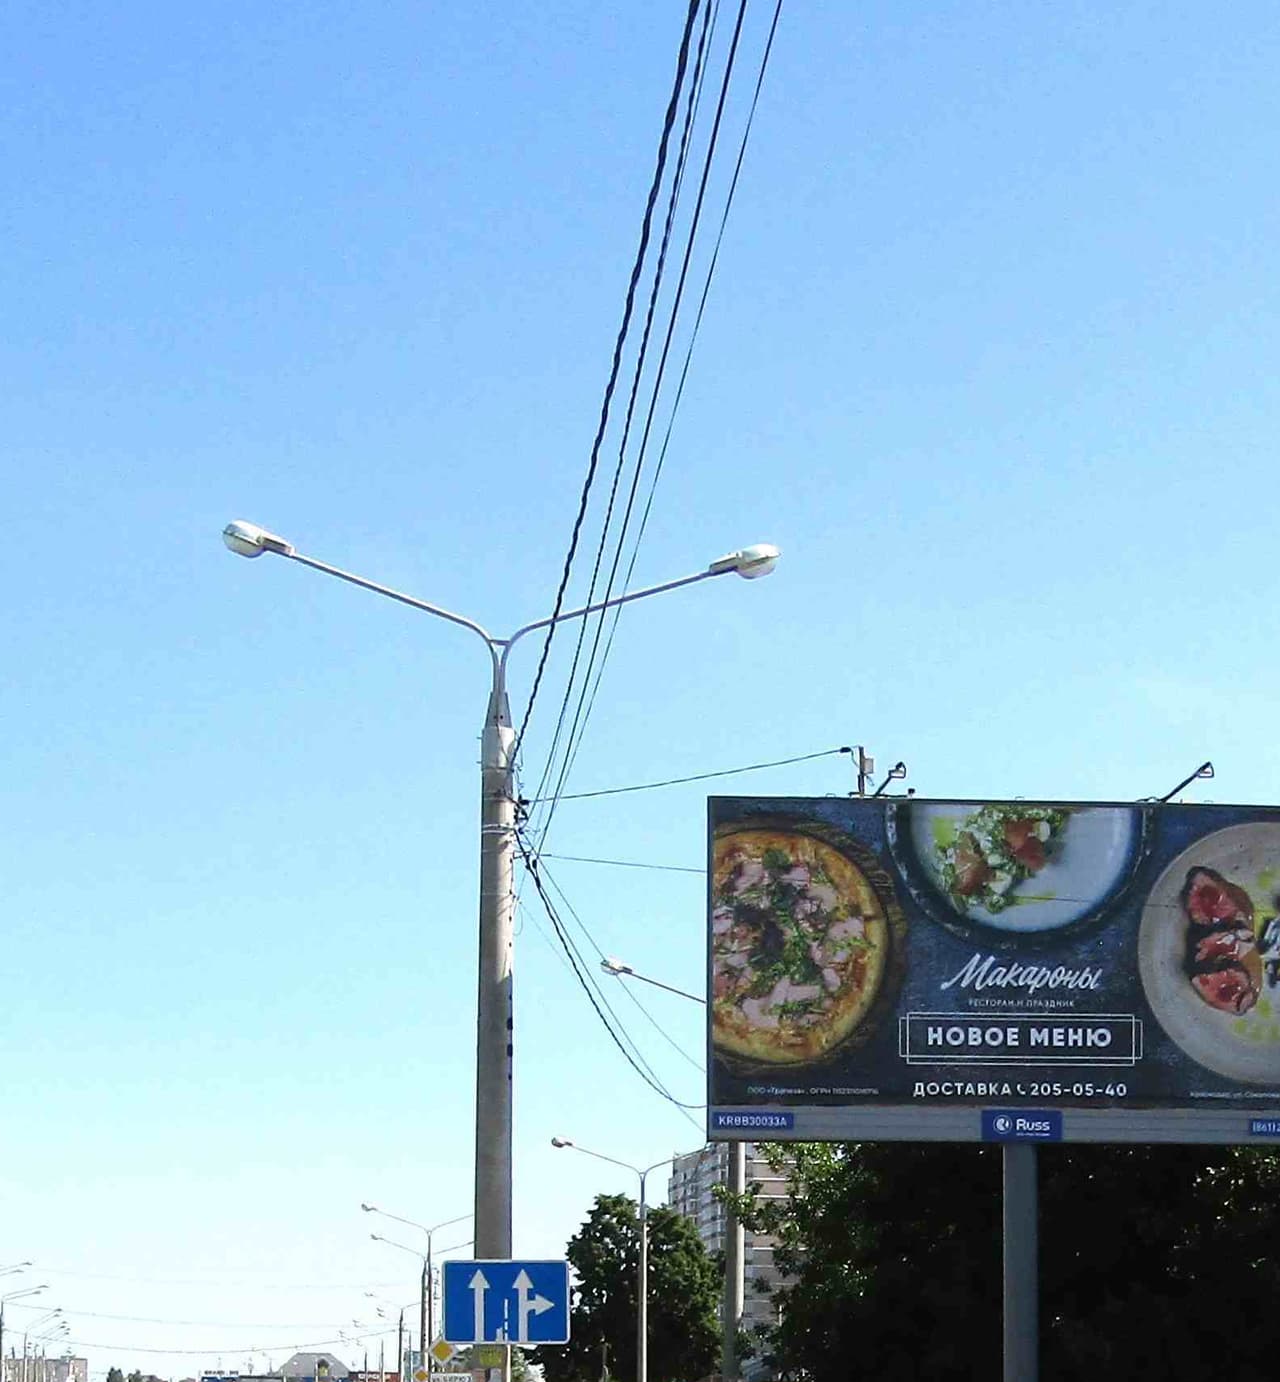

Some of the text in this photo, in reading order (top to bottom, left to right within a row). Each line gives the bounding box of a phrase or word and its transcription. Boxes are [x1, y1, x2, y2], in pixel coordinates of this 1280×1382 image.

[940, 952, 1102, 994] Макароны
[927, 1026, 1112, 1047] НОВОЕ МЕНЮ
[912, 1082, 1127, 1097] ДОСТАВКА 205-05-40
[1016, 1118, 1050, 1131] Russ
